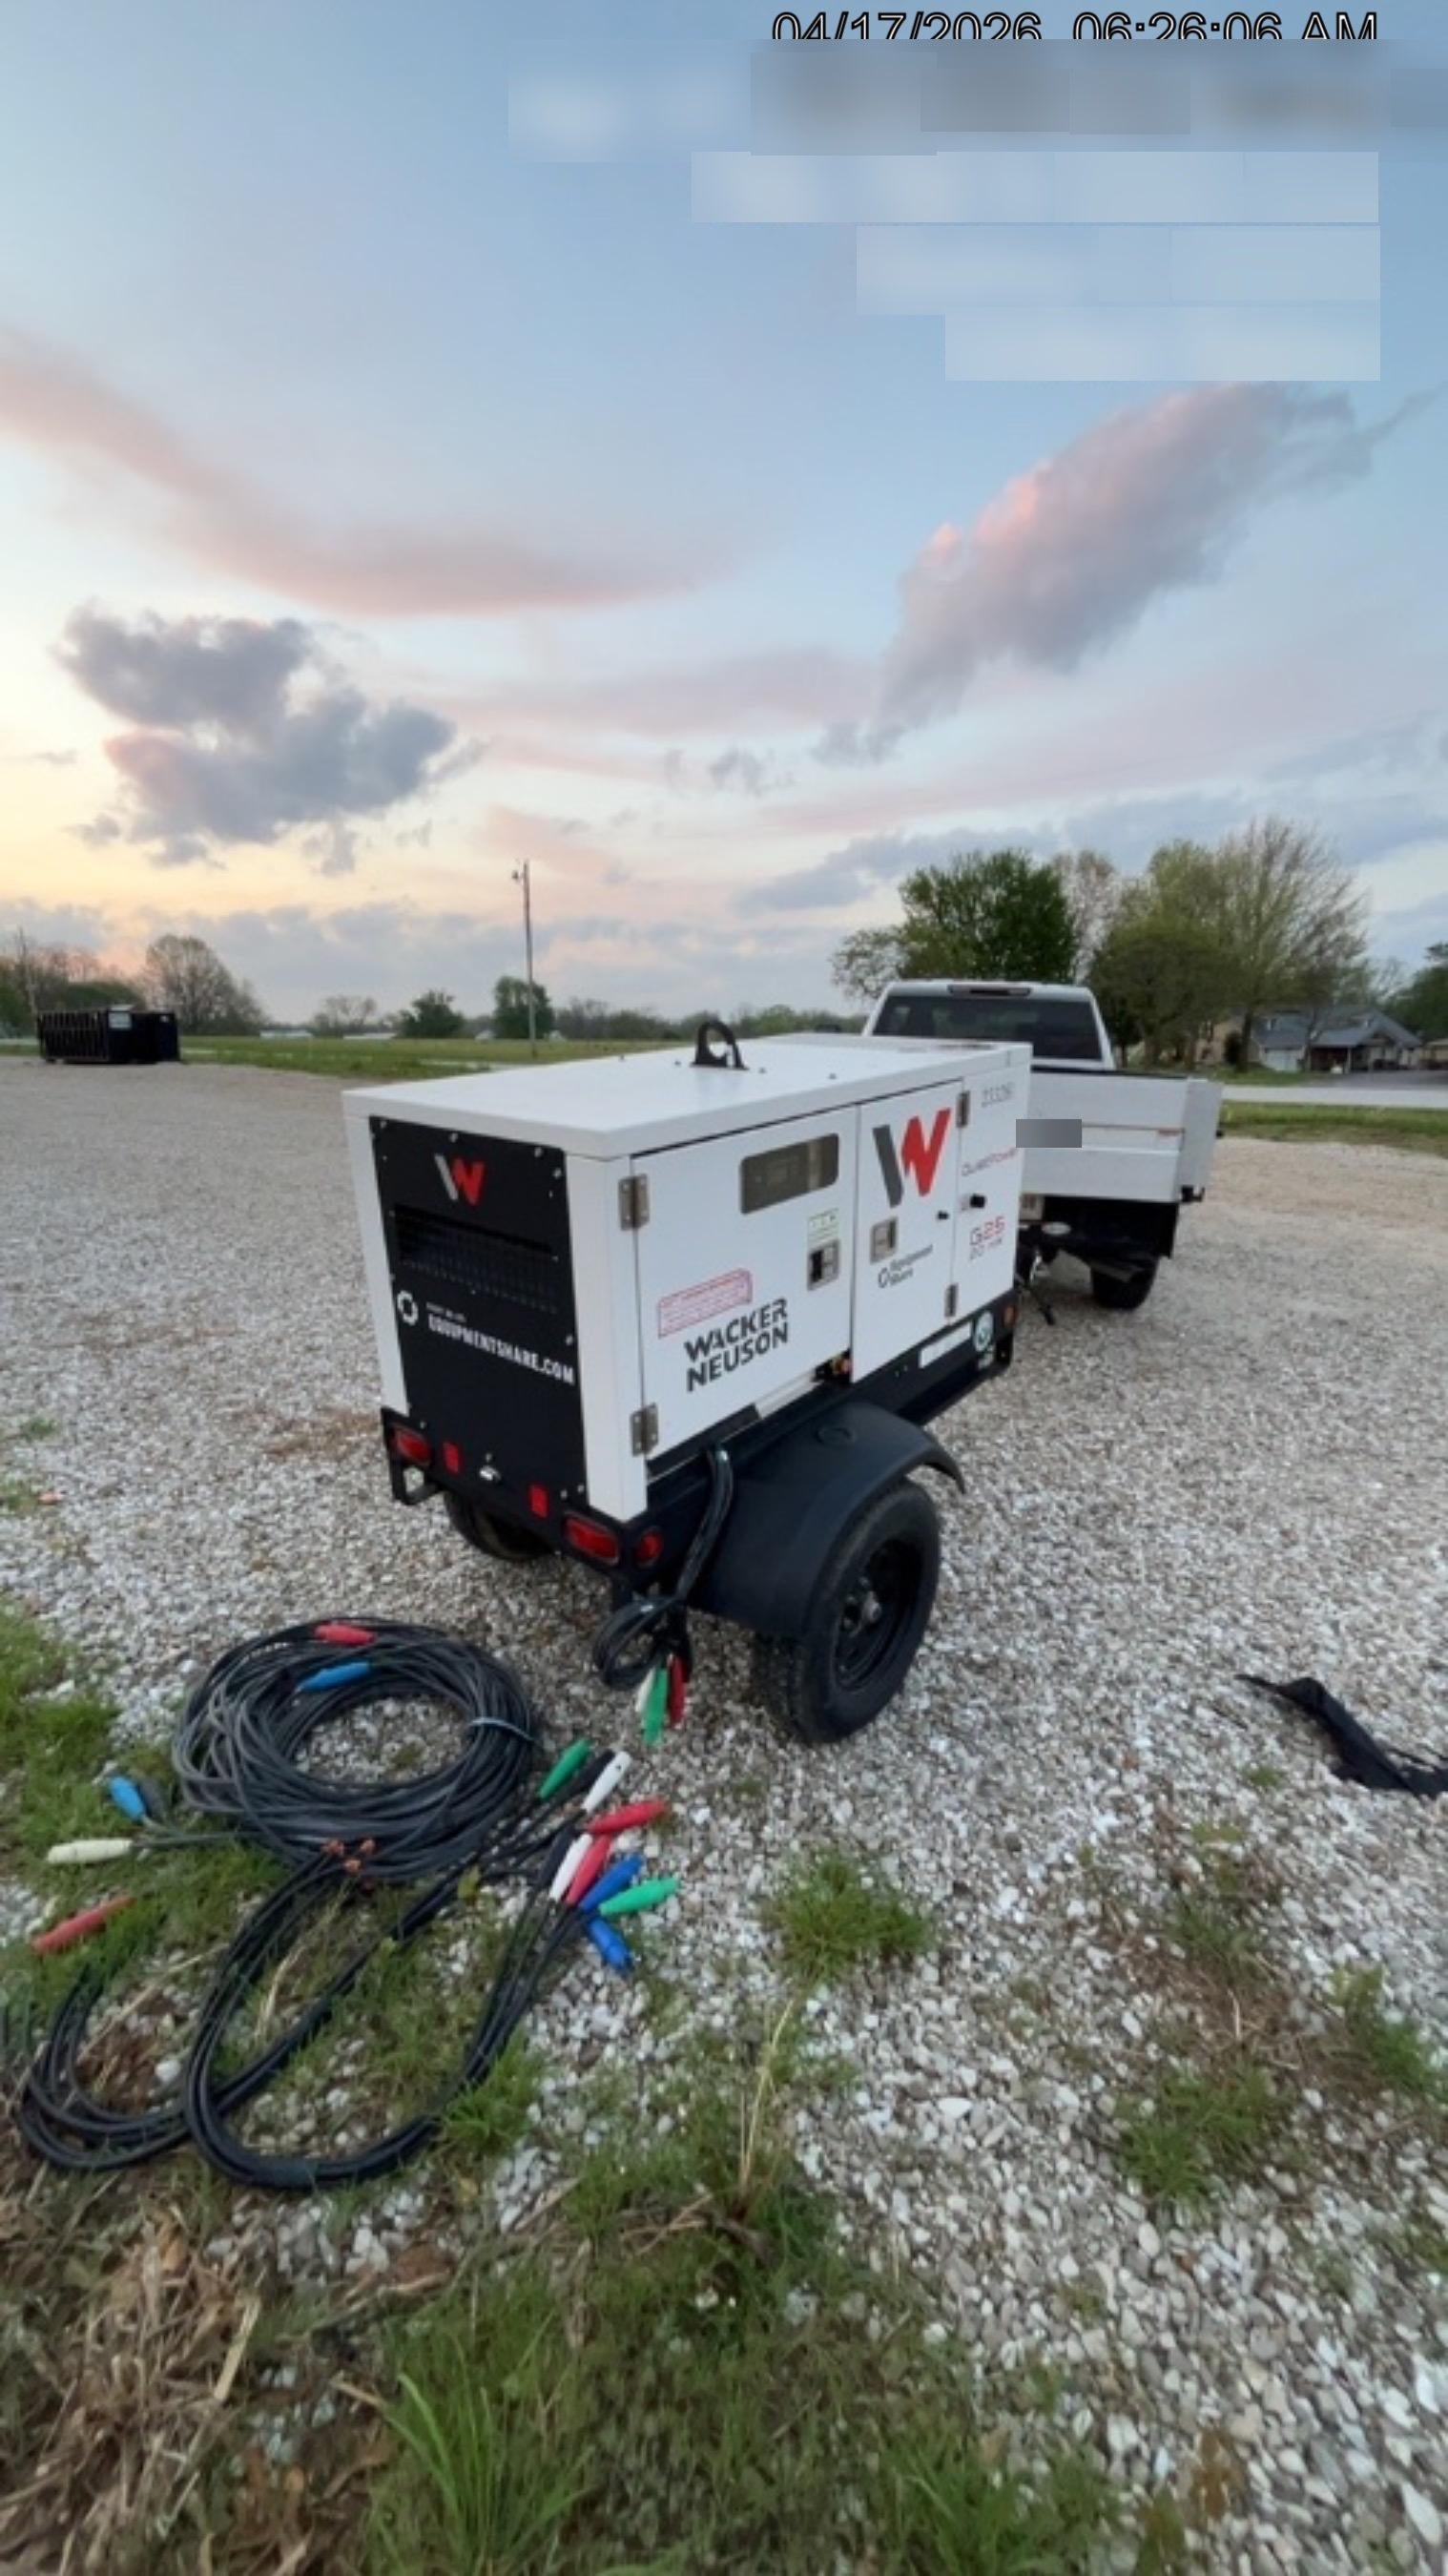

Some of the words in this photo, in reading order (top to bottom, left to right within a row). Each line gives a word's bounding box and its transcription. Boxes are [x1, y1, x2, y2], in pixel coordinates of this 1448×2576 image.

[428, 1313, 574, 1385] EQUIPMENTSHARE.COM
[684, 1298, 788, 1363] WACKER
[686, 1321, 789, 1393] NEUSON
